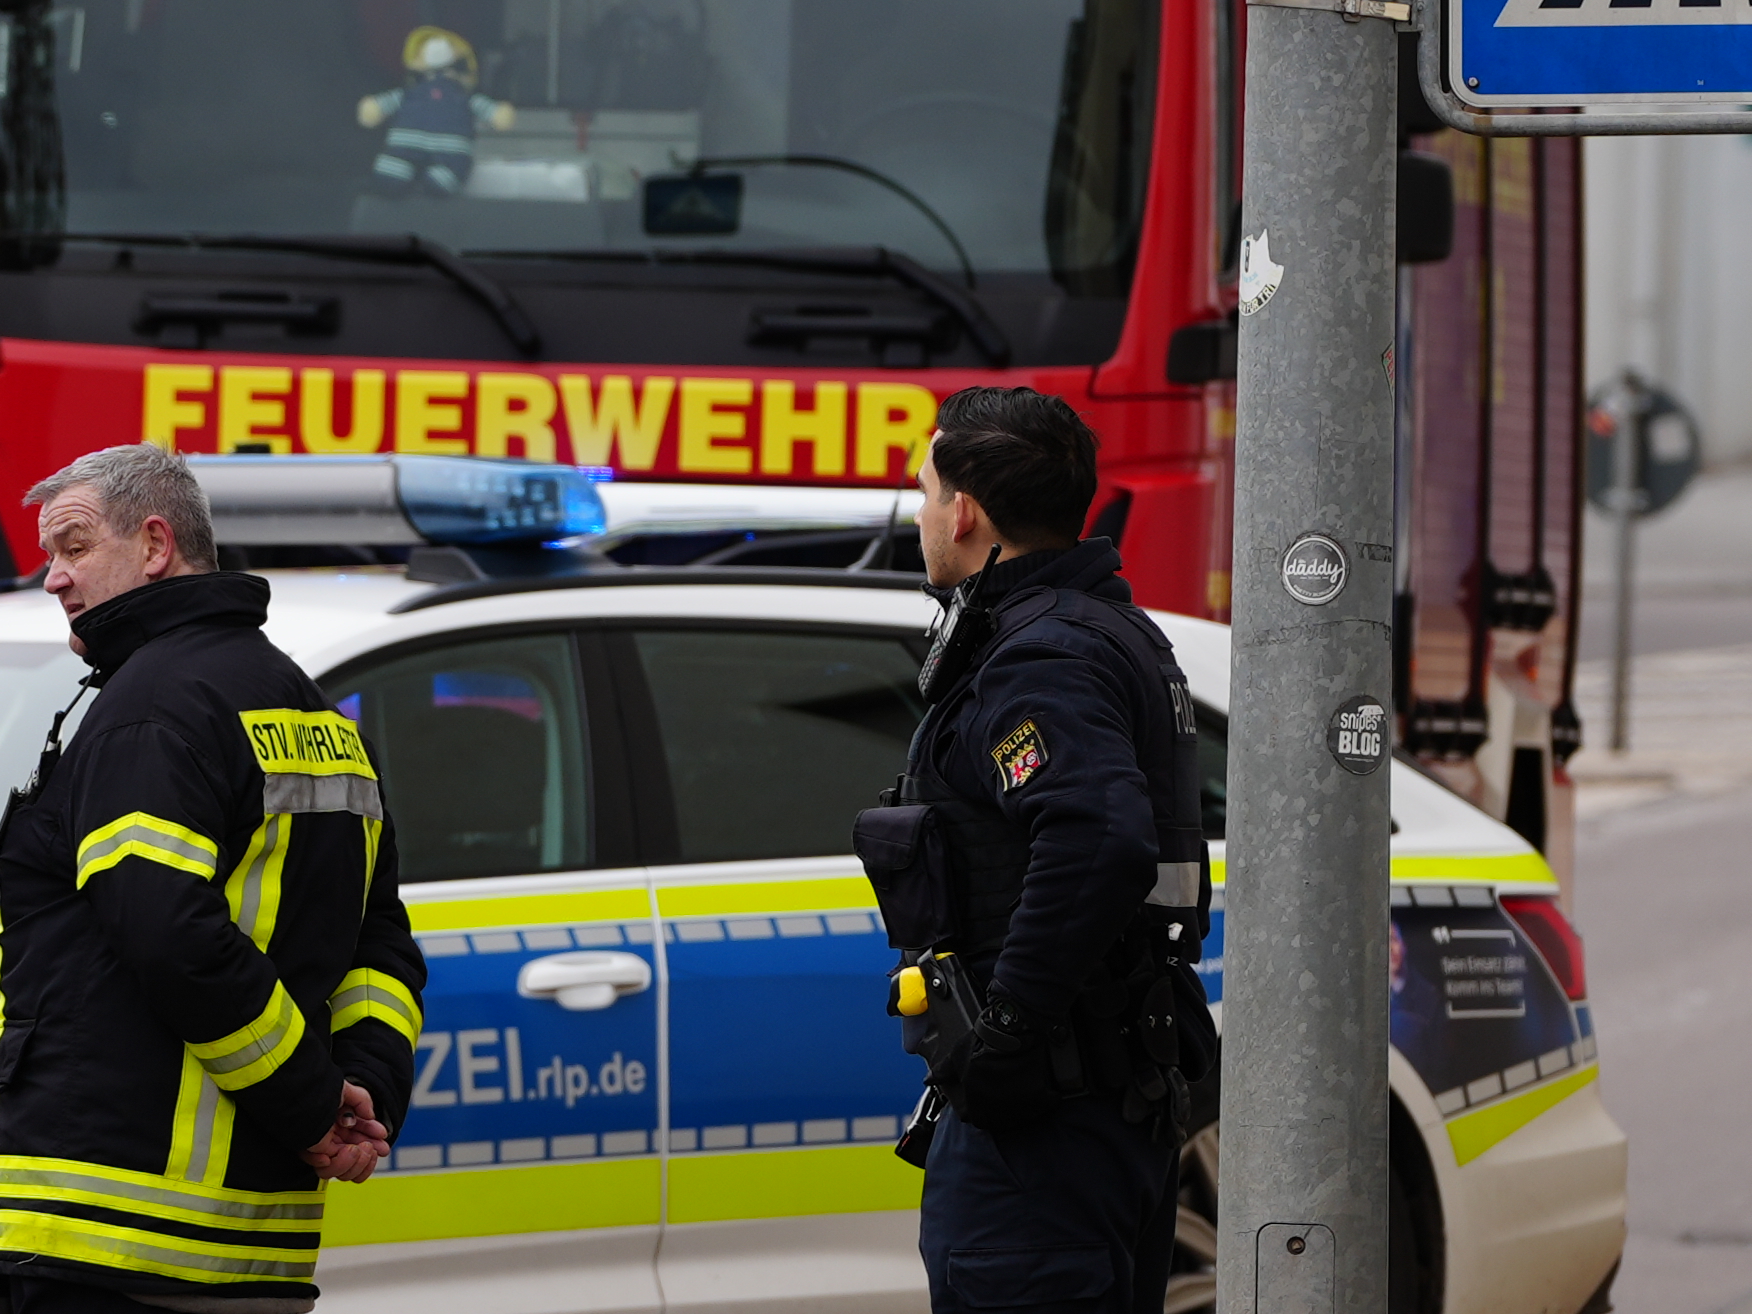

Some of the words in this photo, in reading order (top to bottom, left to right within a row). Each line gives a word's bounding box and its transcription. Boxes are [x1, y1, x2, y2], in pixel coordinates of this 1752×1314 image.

[143, 362, 937, 478] FEUERWEHR
[252, 723, 294, 761] STV.
[995, 720, 1036, 762] POLIZEI
[1338, 730, 1381, 757] BLOG
